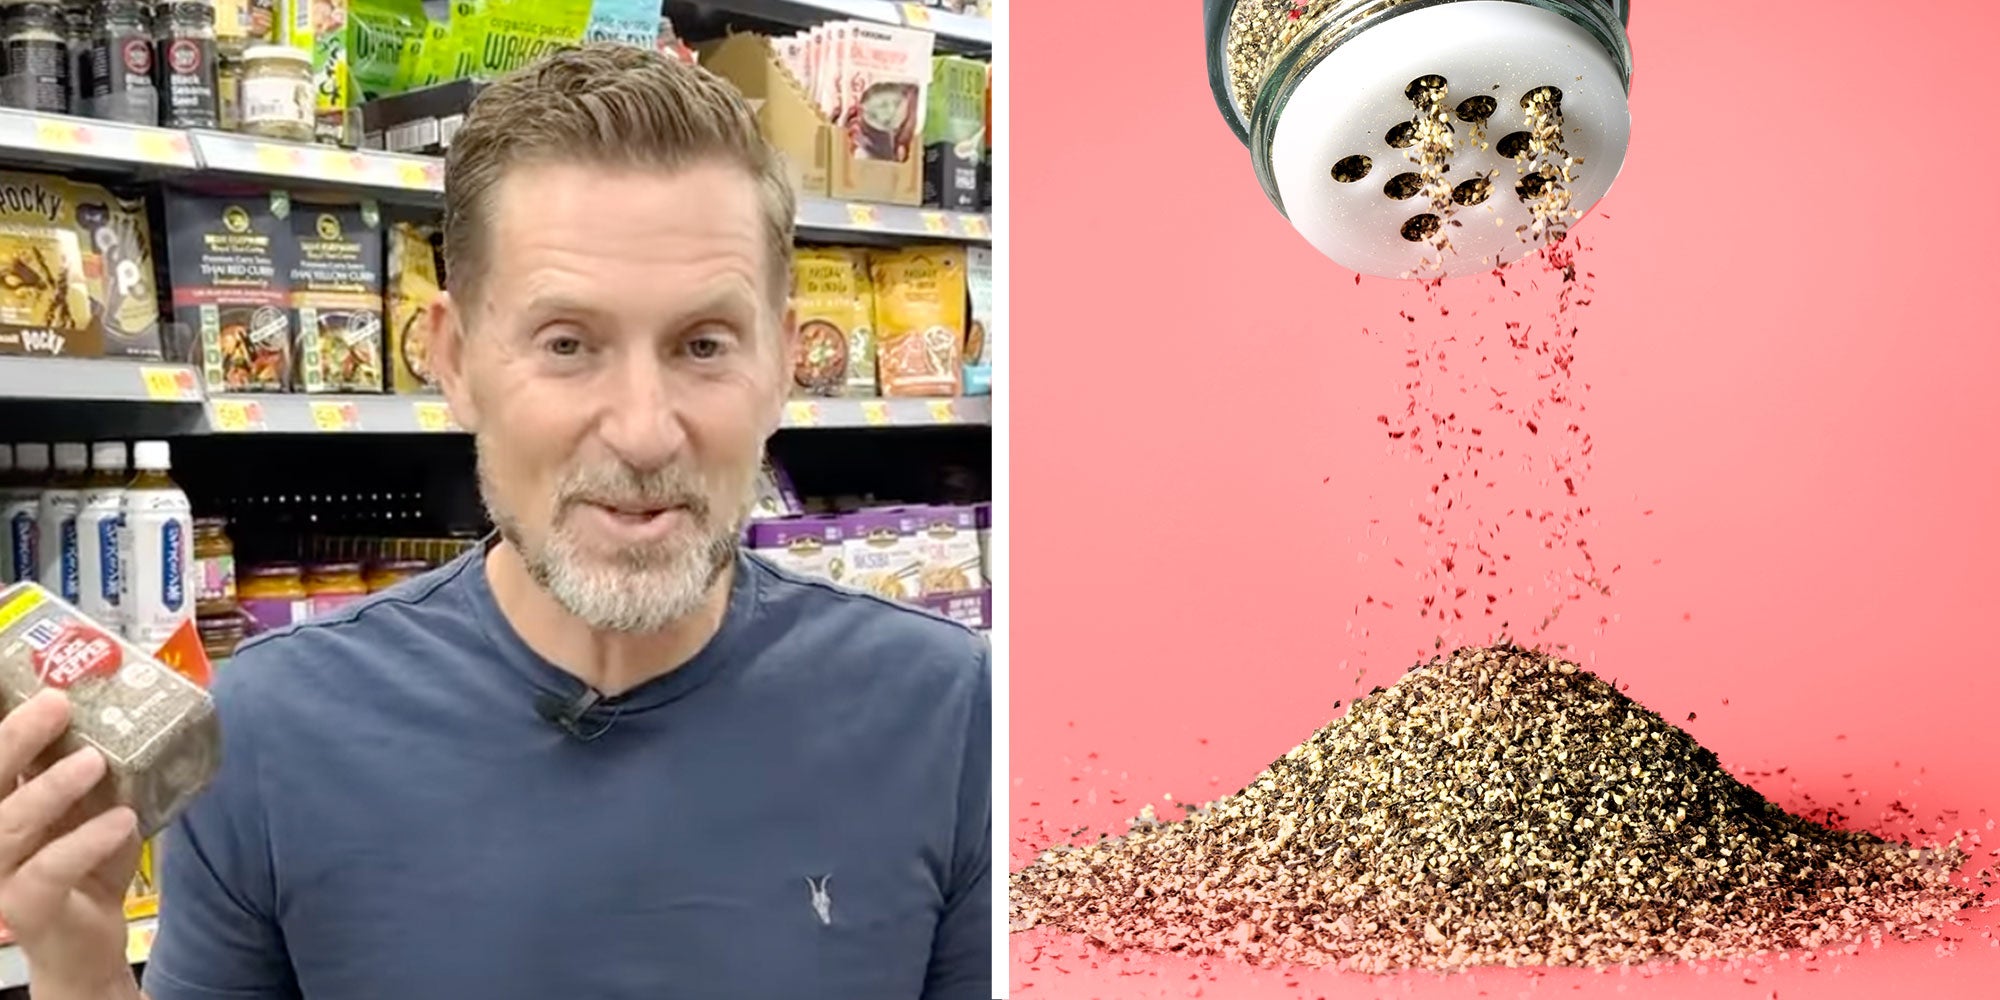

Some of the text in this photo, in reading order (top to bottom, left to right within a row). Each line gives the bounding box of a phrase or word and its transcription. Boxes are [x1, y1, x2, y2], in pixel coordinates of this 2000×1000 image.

[171, 74, 199, 86] Black
[172, 96, 199, 107] Seed
[201, 264, 275, 277] THAI RED CURRY
[313, 271, 348, 281] YELLOW
[349, 272, 376, 283] CURRY
[48, 637, 111, 683] PEPPER
